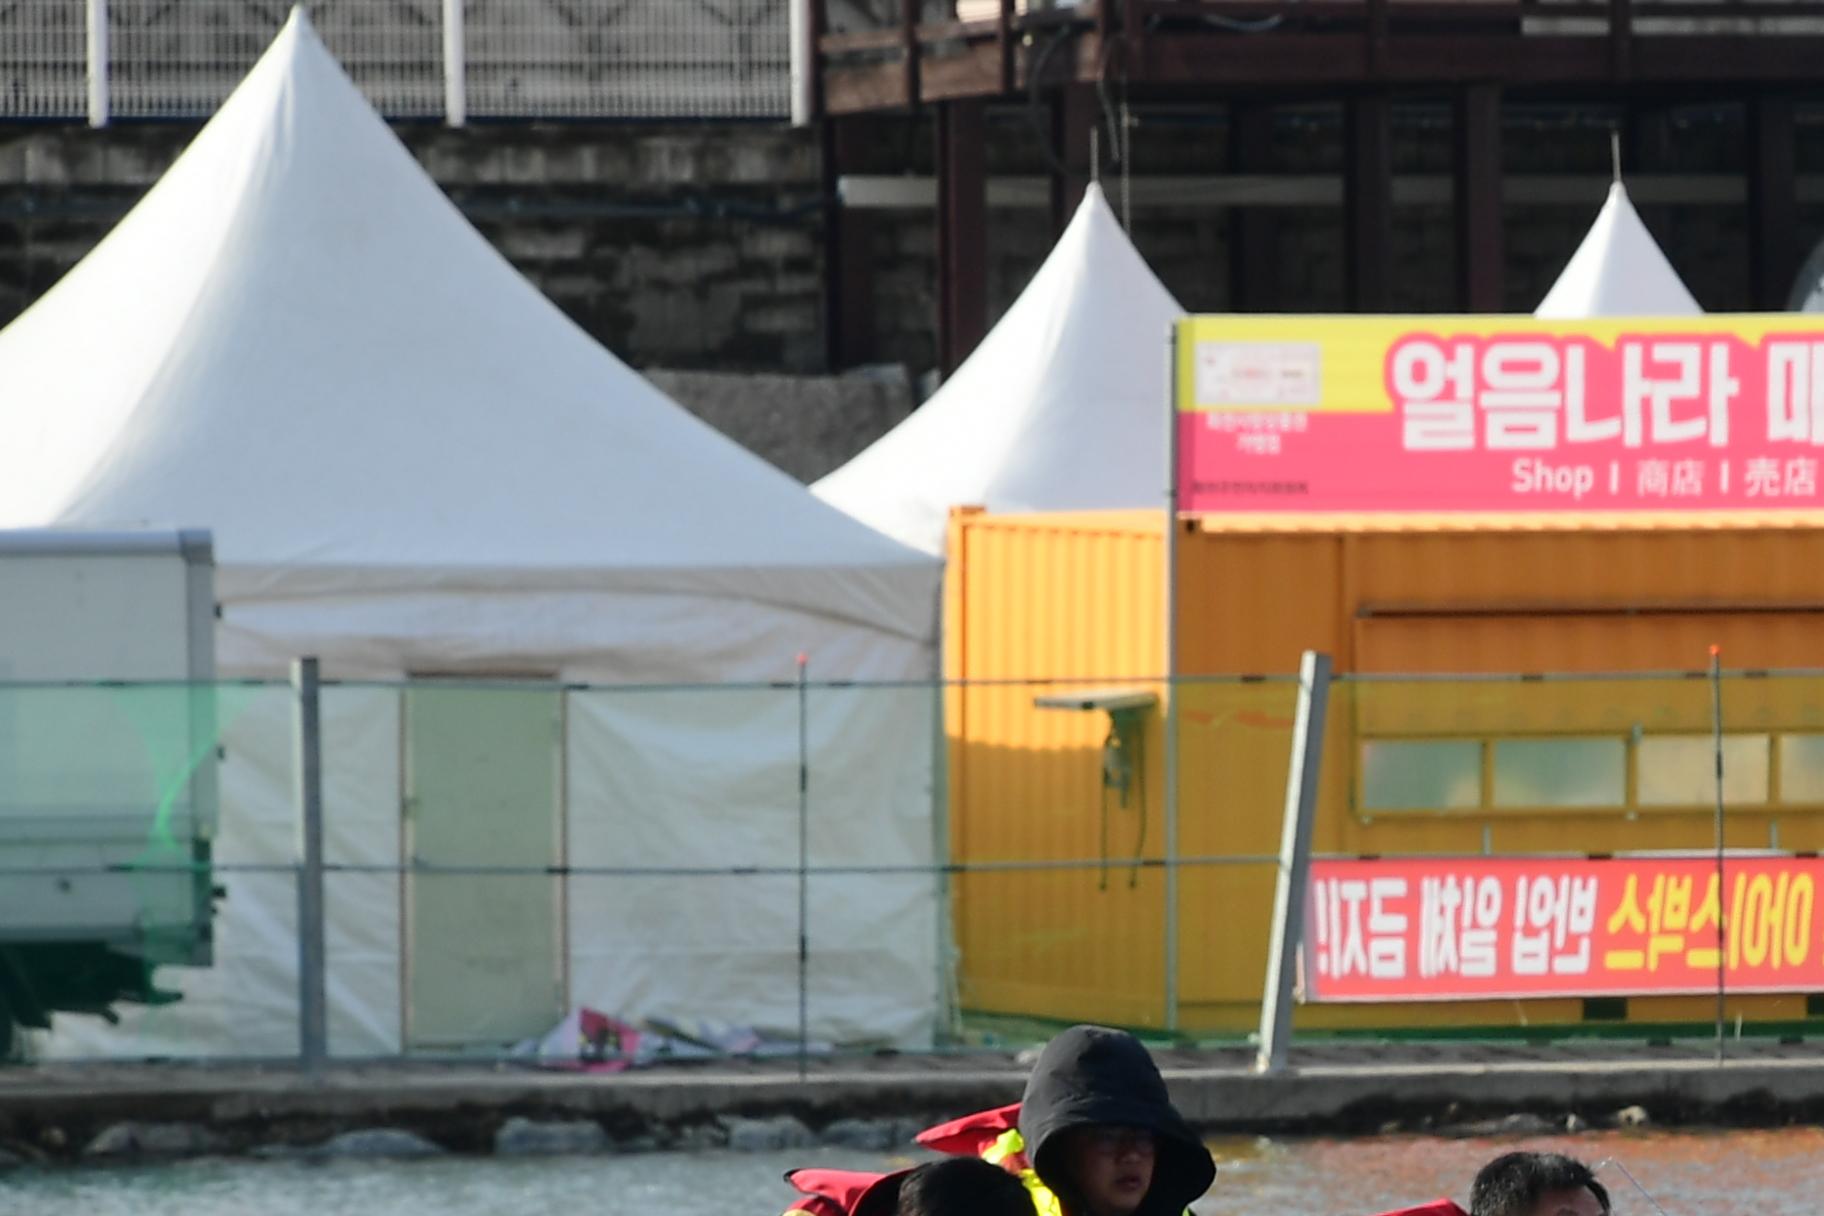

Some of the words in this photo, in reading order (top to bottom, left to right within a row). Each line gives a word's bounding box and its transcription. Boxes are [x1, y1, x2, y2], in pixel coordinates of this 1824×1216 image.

[1392, 341, 1739, 450] 얼음나라
[1512, 458, 1594, 500] Shop
[1637, 459, 1704, 496] 商店
[1745, 458, 1818, 496] 売店
